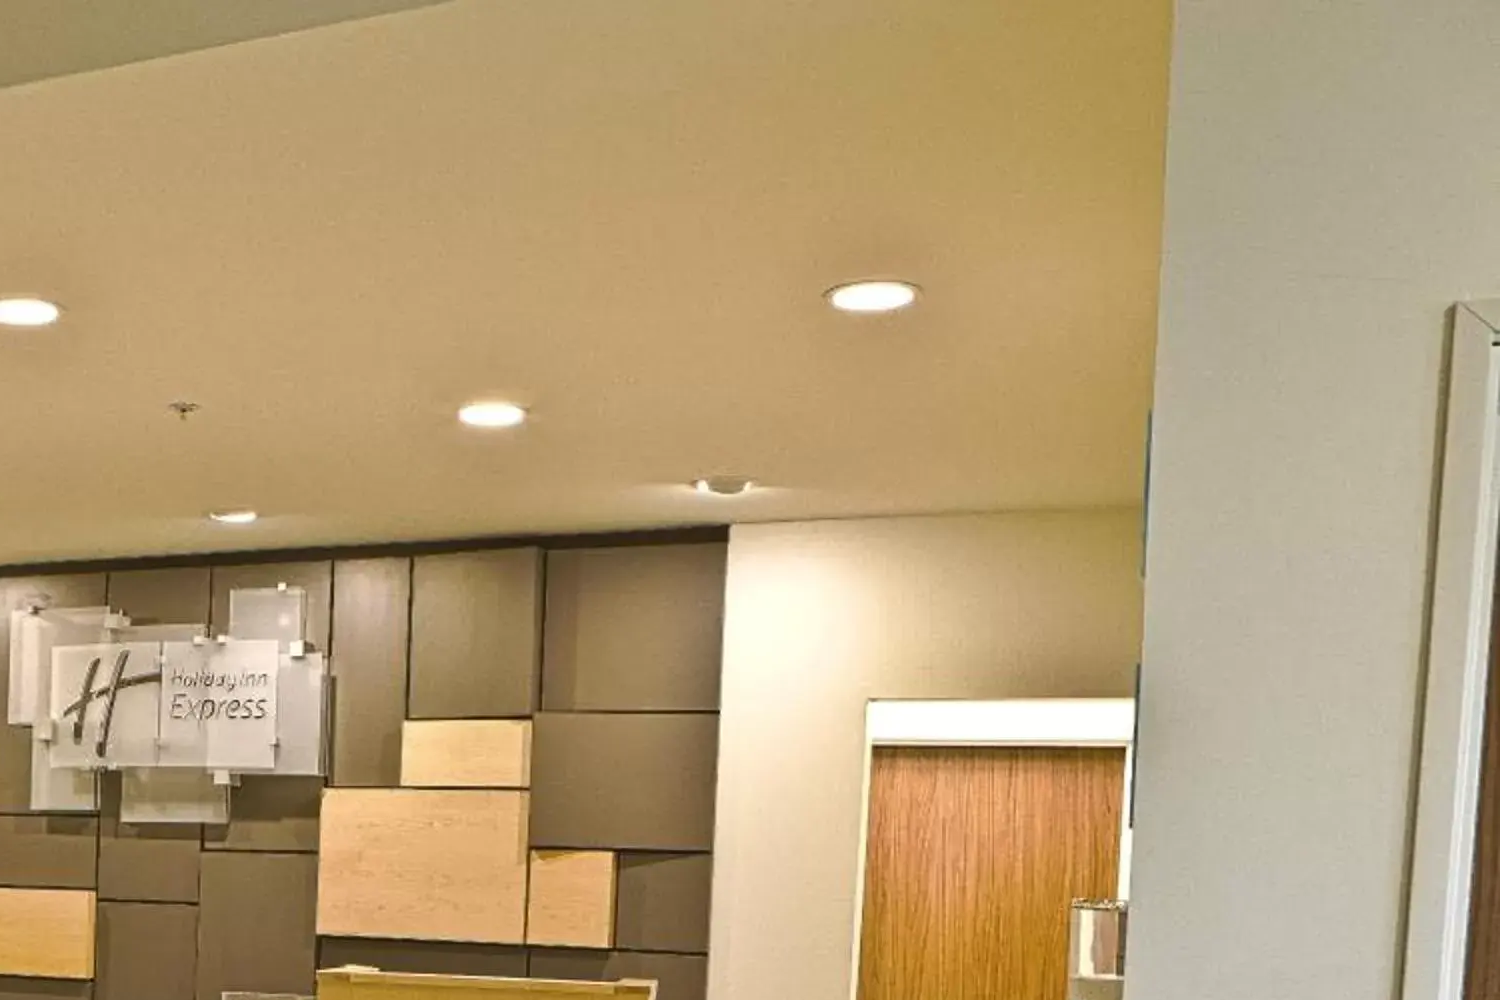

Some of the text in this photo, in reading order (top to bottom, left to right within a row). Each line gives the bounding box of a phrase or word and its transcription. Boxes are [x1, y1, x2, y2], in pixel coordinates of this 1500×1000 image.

[171, 667, 269, 692] Holiday Inn
[170, 692, 268, 720] Express
